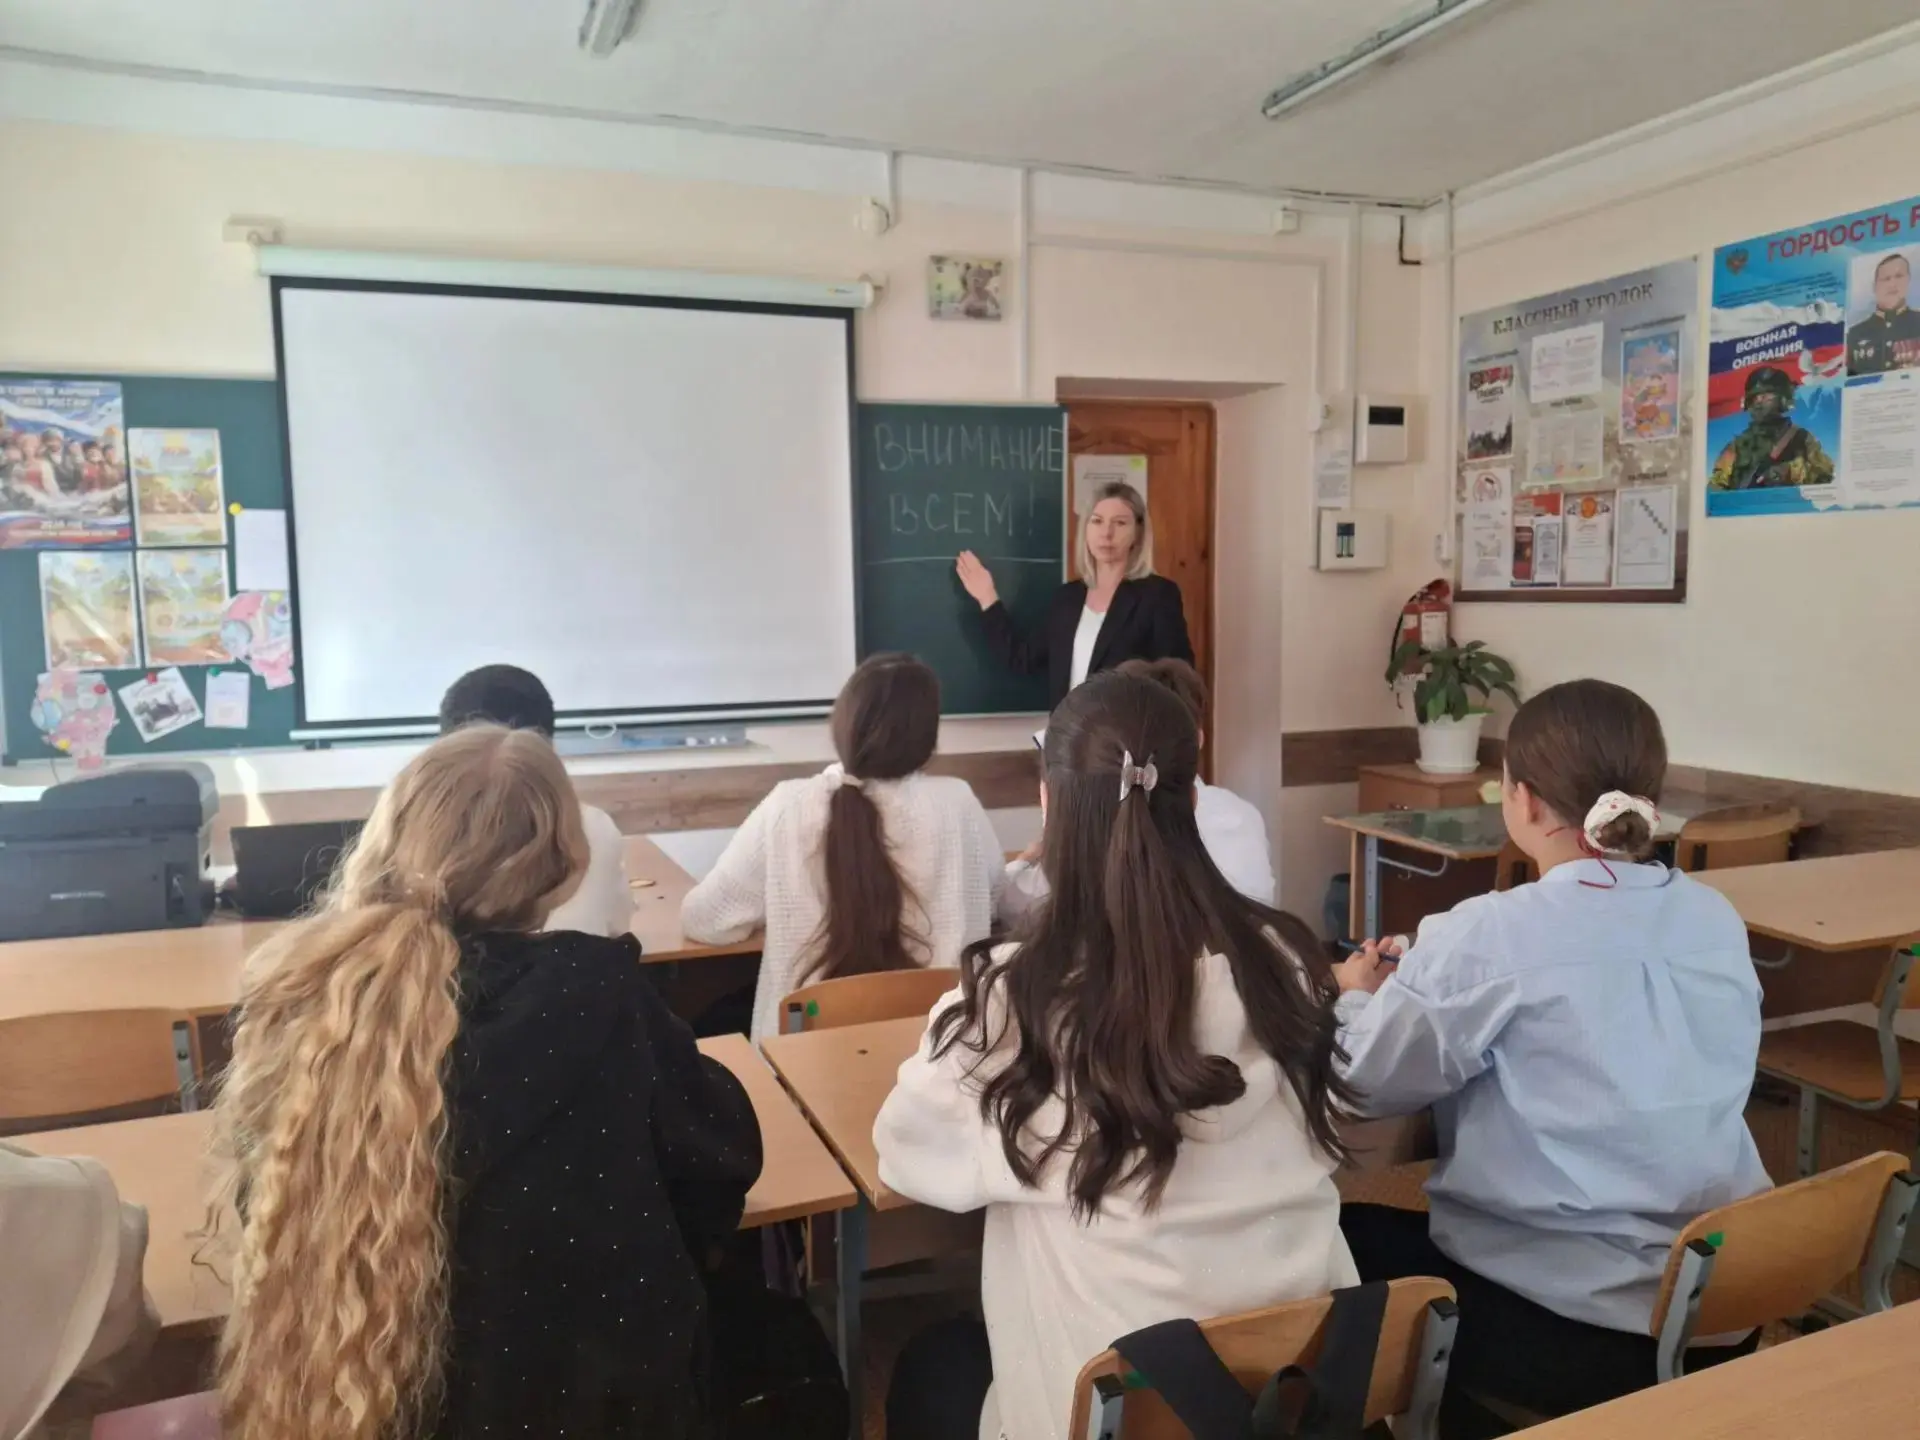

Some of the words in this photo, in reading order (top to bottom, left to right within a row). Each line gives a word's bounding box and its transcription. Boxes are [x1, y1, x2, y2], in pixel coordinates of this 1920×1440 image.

[1767, 212, 1901, 263] ГОРДОСТЬ
[1492, 296, 1580, 335] КЛАССНЫЙ
[1585, 283, 1654, 314] УГОЛОК
[1732, 340, 1804, 370] ОПЕРАЦИЯ
[1735, 324, 1798, 354] ВОЕННАЯ
[874, 421, 1065, 472] ВНИМАНИЕ
